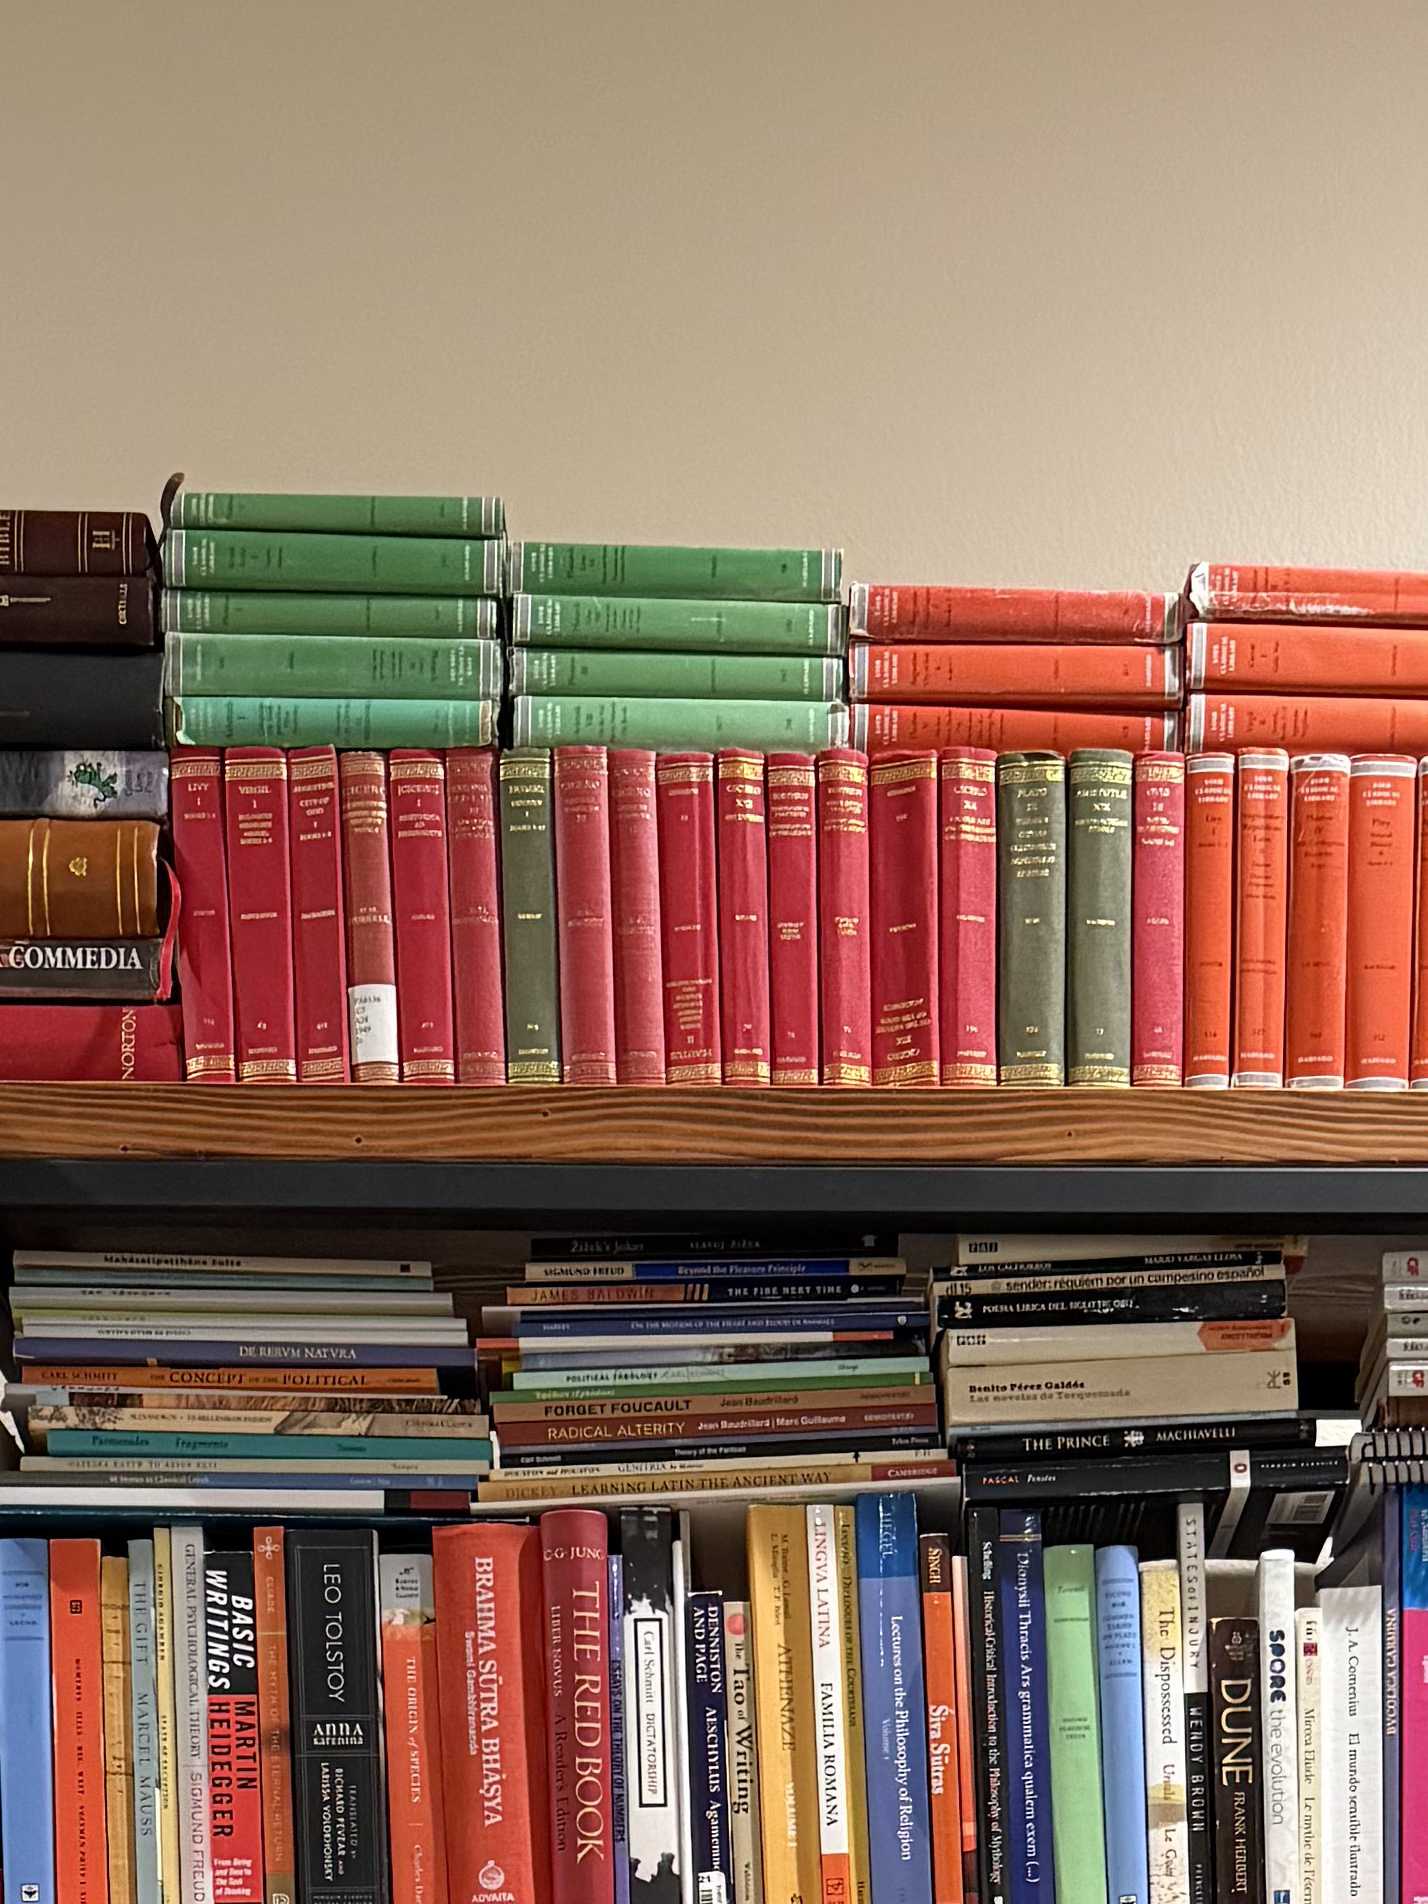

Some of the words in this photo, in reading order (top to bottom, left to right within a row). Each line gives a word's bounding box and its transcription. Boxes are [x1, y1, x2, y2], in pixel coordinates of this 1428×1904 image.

[8, 945, 142, 969] COMMEDIA
[1022, 1435, 1052, 1452] THE
[1056, 1433, 1111, 1450] PRINCE
[1157, 1427, 1236, 1442] MACHIAVELLI
[323, 1563, 342, 1605] LEO
[206, 1570, 229, 1689] WRITINGS
[230, 1595, 254, 1670] BASIC
[323, 1611, 346, 1703] TOLSTOY
[208, 1700, 234, 1839] HEIDEGGER
[234, 1701, 258, 1790] MARTIN
[1219, 1678, 1253, 1786] DUNE
